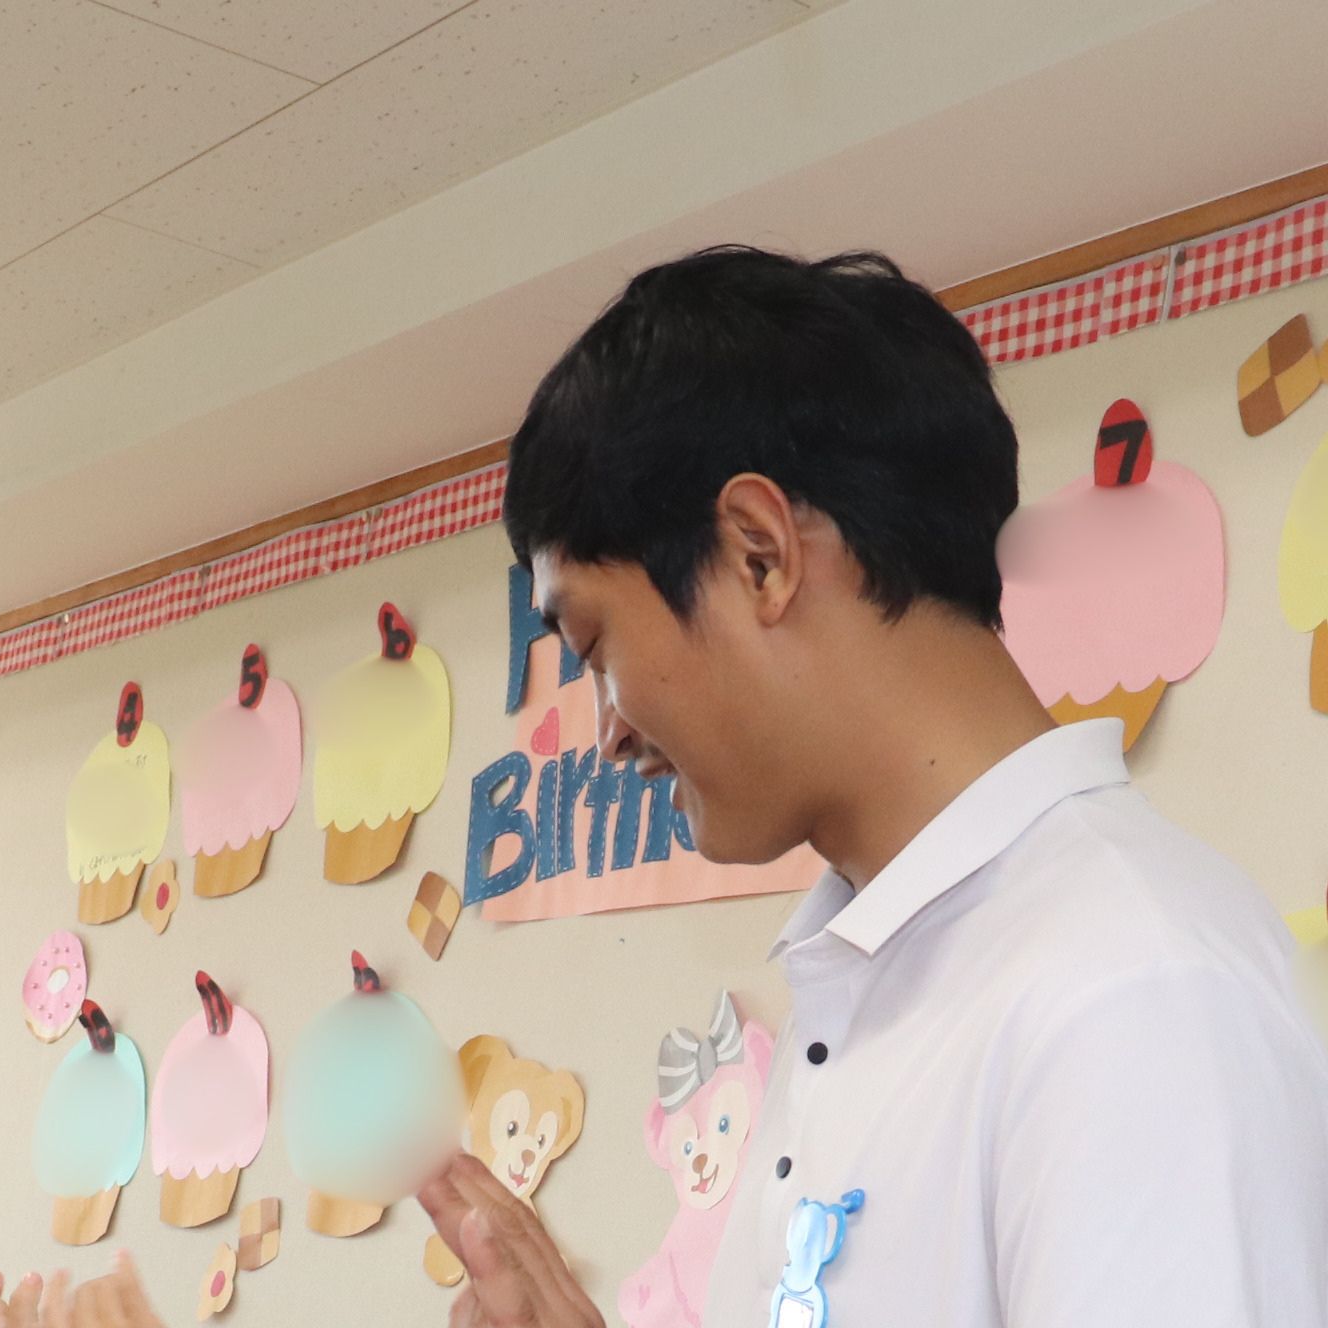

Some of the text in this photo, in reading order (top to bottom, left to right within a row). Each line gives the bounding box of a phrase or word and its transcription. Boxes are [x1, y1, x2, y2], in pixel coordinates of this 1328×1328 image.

[1098, 419, 1147, 484] 7
[383, 612, 411, 660] 6
[239, 654, 262, 708] 5
[117, 692, 138, 741] 4
[463, 738, 698, 908] Birth
